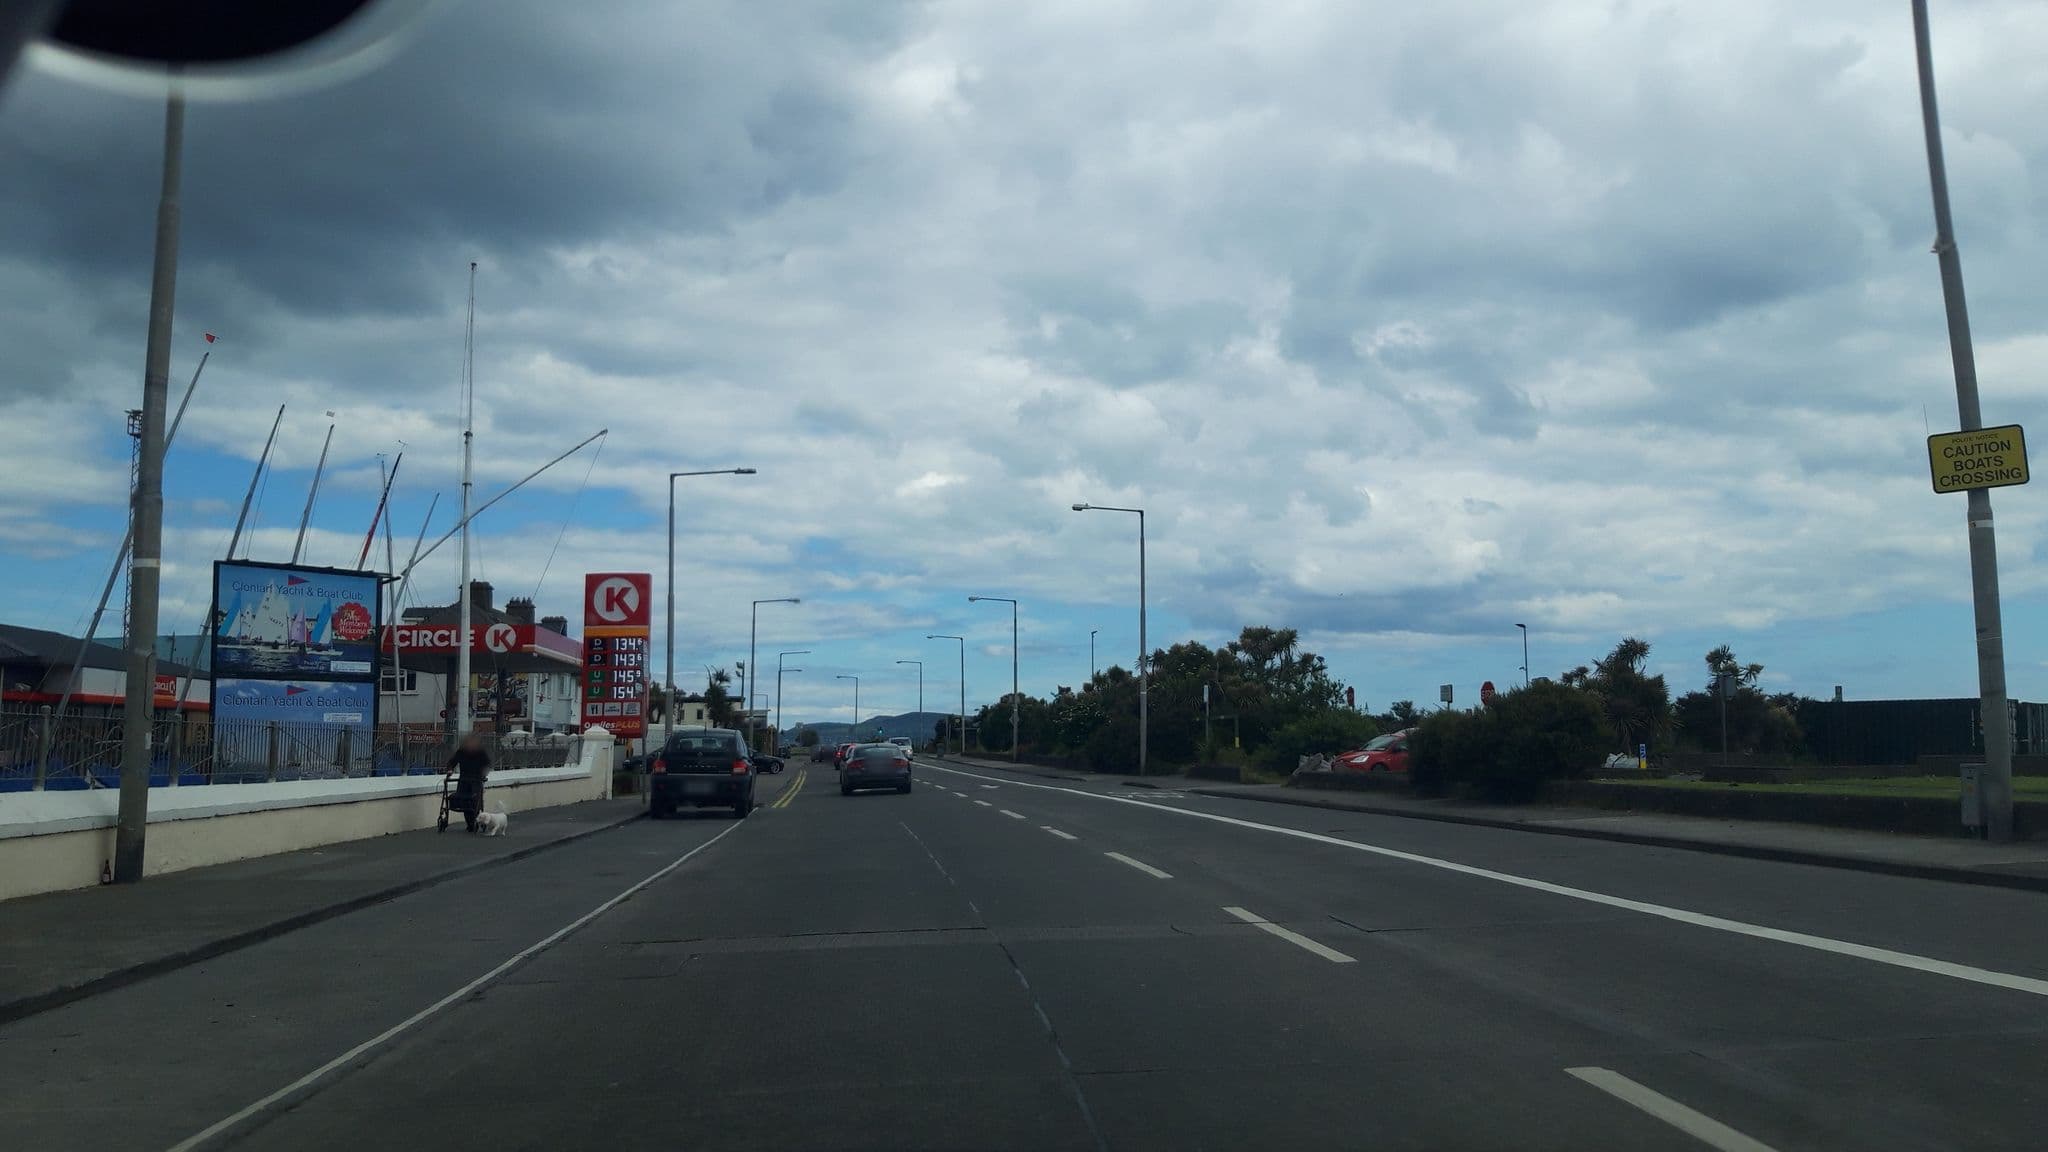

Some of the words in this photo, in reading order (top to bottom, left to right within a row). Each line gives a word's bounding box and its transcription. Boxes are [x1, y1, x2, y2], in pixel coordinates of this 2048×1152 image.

[1943, 440, 2011, 459] CAUTION
[1953, 455, 2004, 472] BOATS
[1940, 467, 2022, 487] CROSSING
[232, 580, 273, 593] Clontarf
[276, 585, 304, 596] Yacht
[306, 586, 314, 597] &
[317, 587, 339, 599] Boat
[341, 589, 364, 600] Club
[605, 586, 636, 619] K
[222, 694, 268, 706] Clontarf
[271, 696, 303, 707] Yacht
[305, 696, 313, 707] &
[317, 696, 342, 707] Boat
[344, 696, 369, 708] Club
